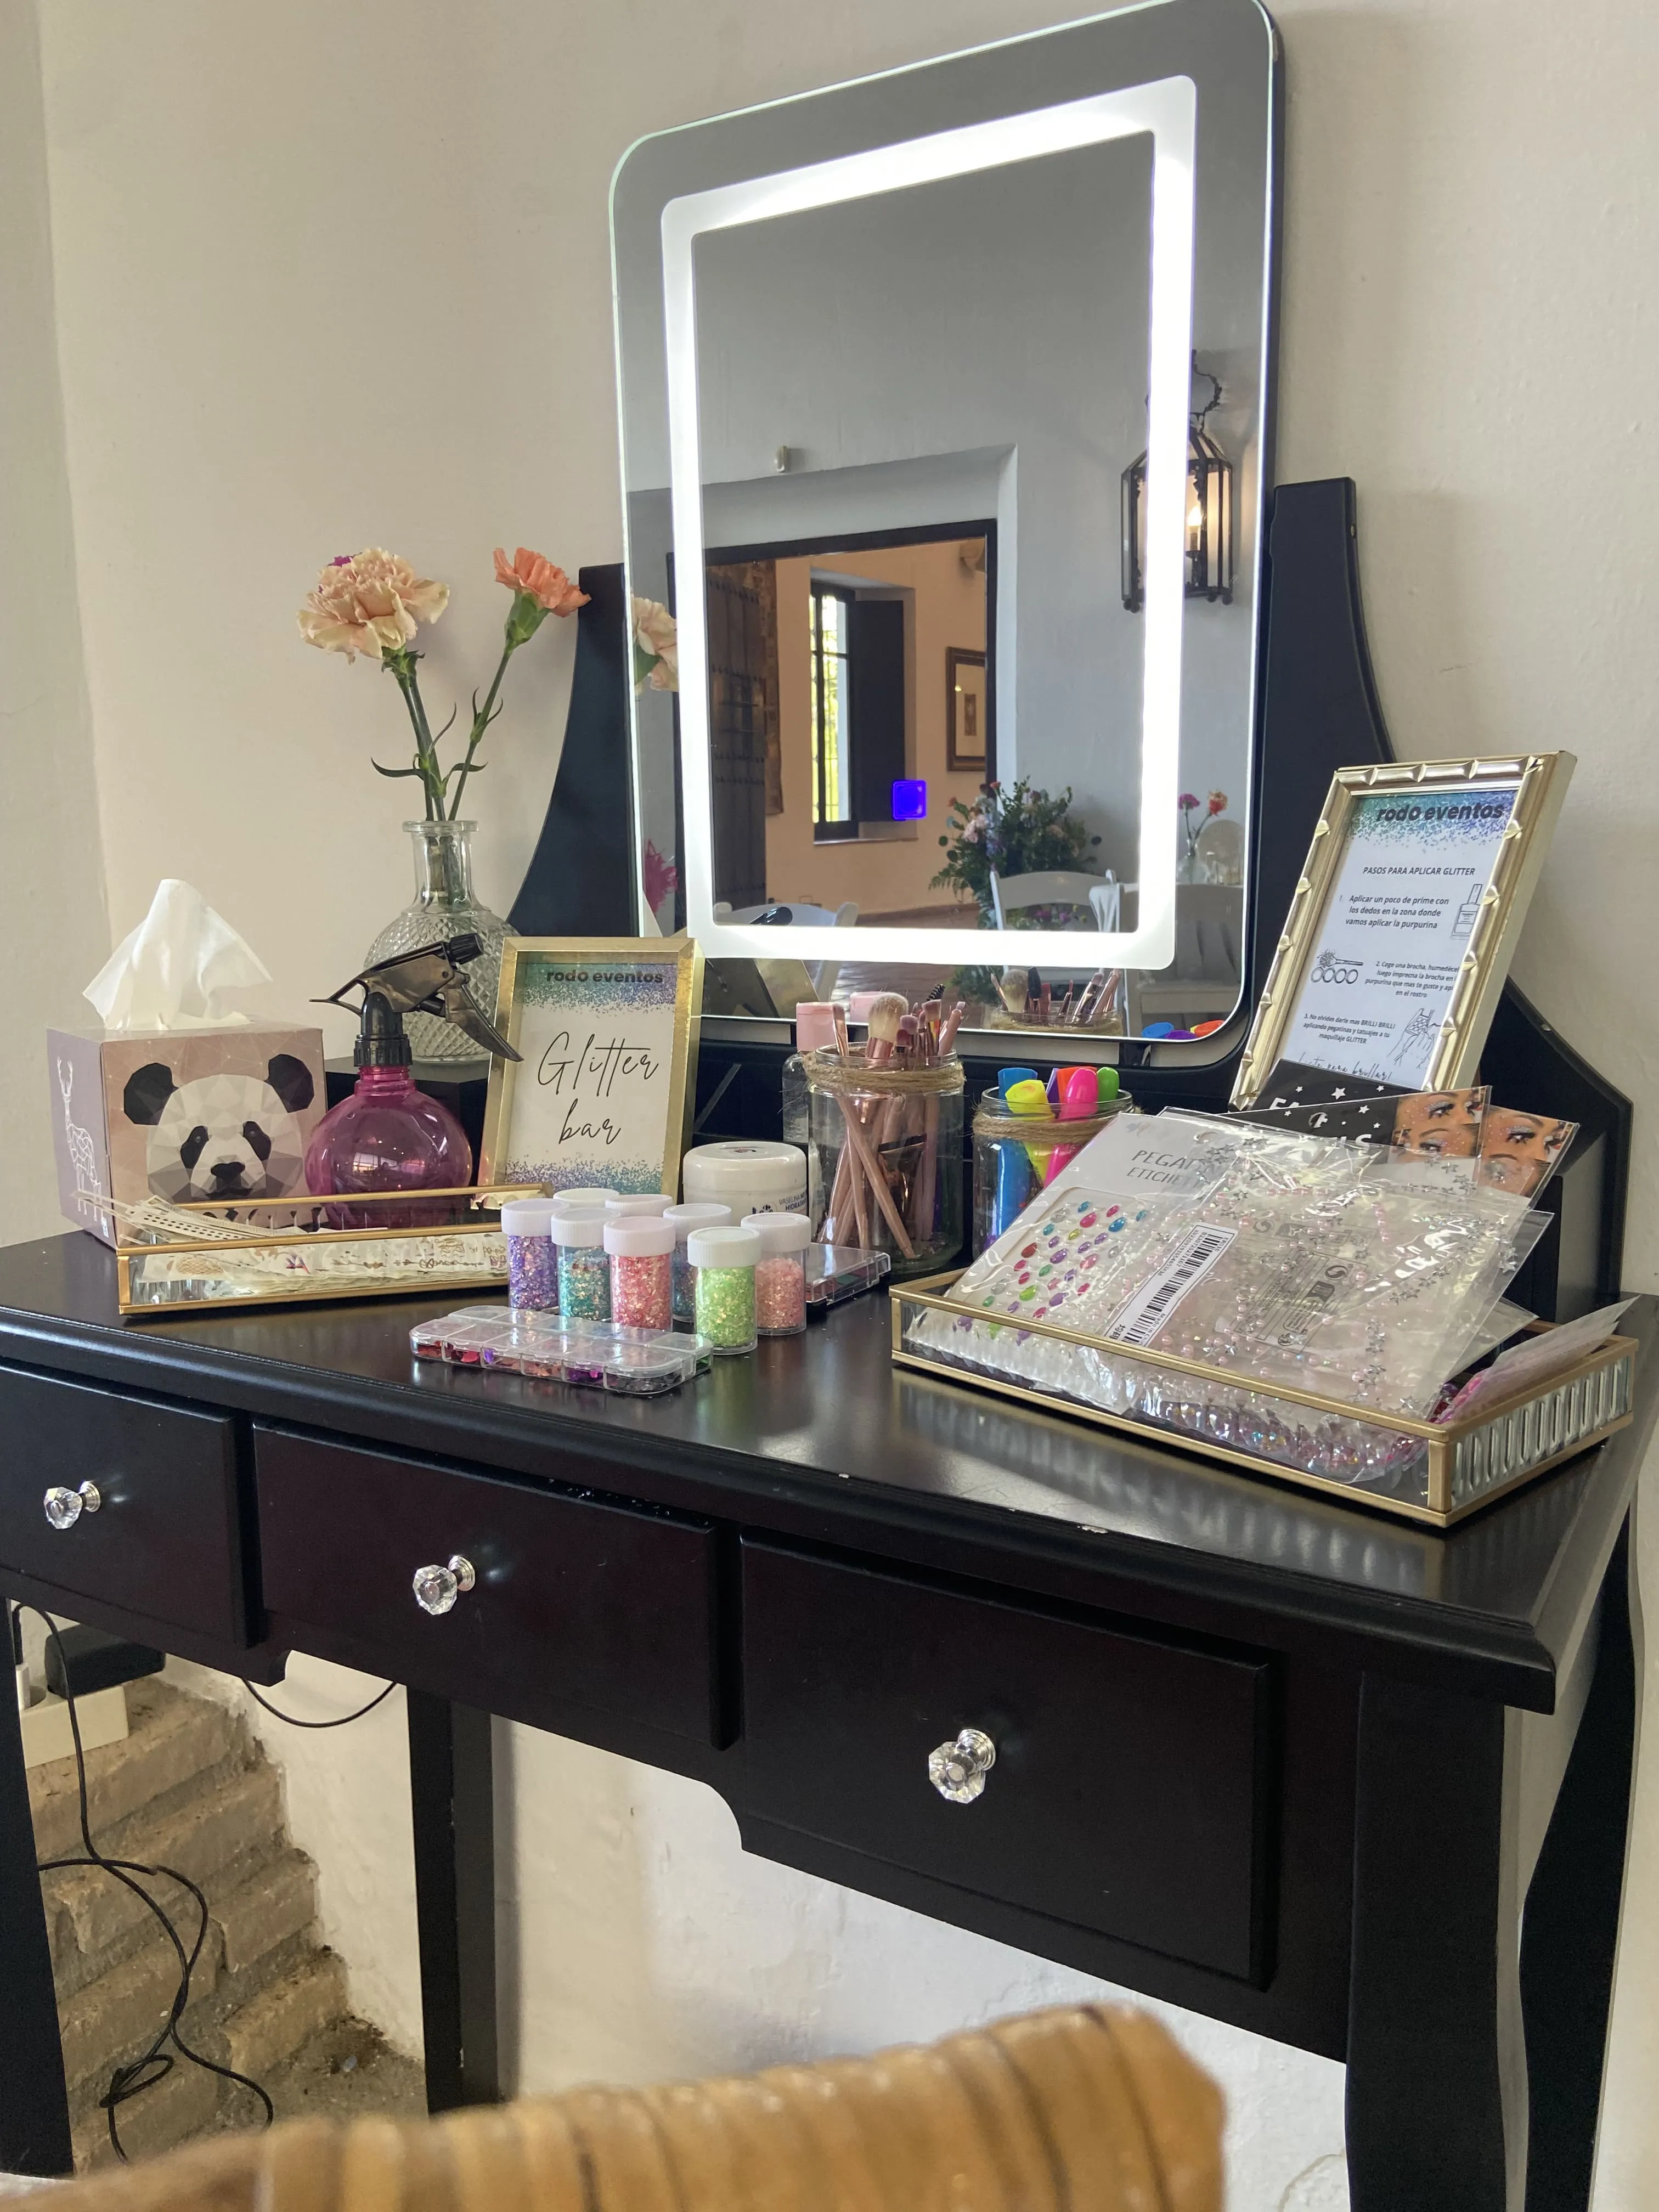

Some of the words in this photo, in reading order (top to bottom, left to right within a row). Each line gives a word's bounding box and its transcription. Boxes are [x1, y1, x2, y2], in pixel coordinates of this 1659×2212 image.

[1376, 805, 1421, 821] rodo
[1424, 802, 1504, 820] eventos
[1349, 895, 1373, 904] Aplicar
[1412, 898, 1434, 906] prime
[1368, 918, 1392, 928] aplicar
[1401, 921, 1438, 930] purpurina
[546, 969, 589, 983] rodo
[592, 970, 664, 983] eventos
[1303, 1022, 1327, 1030] aplicando
[1327, 1025, 1352, 1034] pegatinas
[537, 1031, 660, 1097] Glitter
[558, 1098, 622, 1145] bar
[1139, 1334, 1150, 1345] Chin
